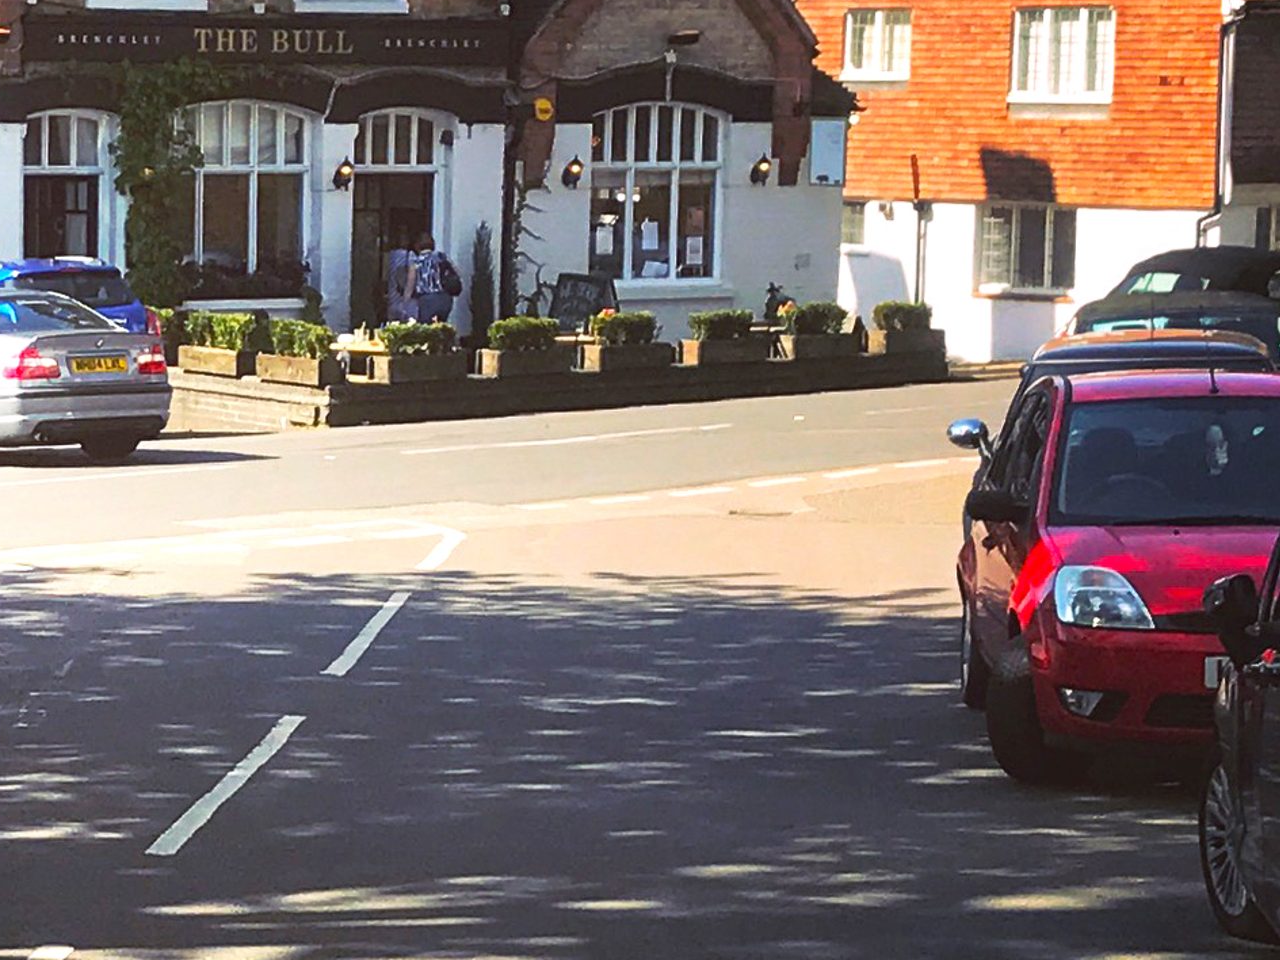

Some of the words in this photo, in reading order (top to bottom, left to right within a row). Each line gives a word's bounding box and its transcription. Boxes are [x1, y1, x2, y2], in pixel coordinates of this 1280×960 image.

[57, 35, 161, 45] BRENCHLEY
[193, 28, 258, 53] THE
[271, 29, 354, 54] BULL
[384, 38, 480, 48] BRENCHLEY
